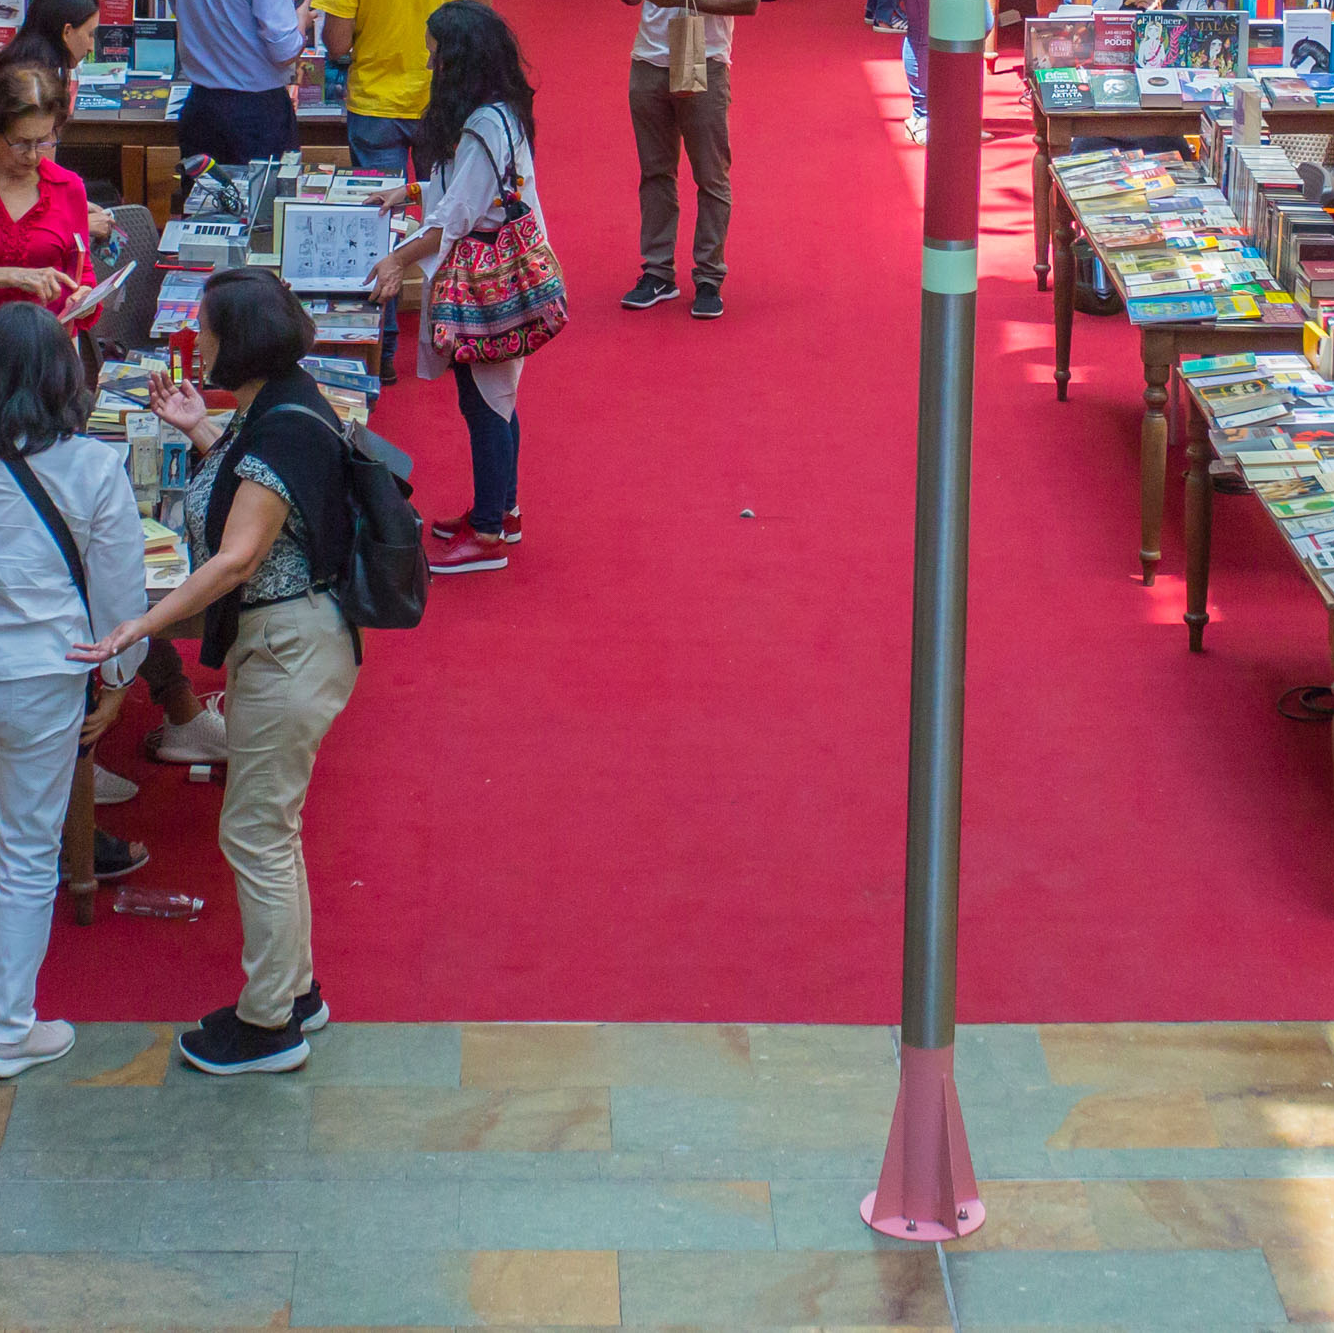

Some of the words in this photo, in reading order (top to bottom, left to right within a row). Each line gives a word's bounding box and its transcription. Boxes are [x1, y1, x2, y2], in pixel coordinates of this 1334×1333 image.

[1142, 15, 1151, 25] El
[1155, 15, 1183, 25] Placer
[1194, 21, 1237, 32] MALAS
